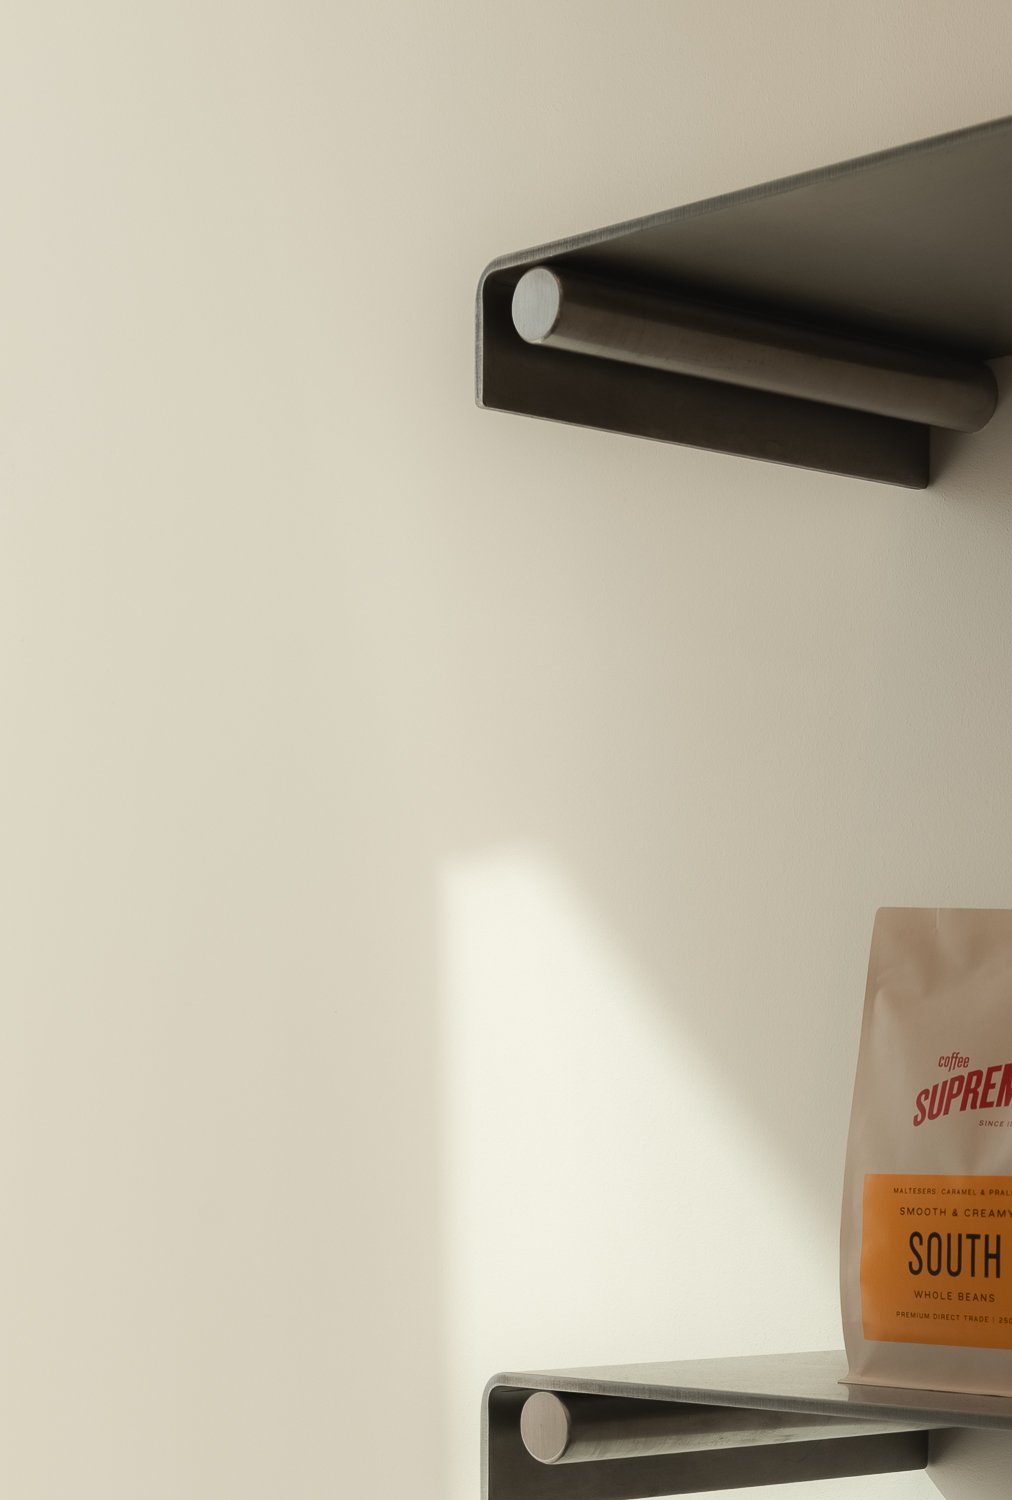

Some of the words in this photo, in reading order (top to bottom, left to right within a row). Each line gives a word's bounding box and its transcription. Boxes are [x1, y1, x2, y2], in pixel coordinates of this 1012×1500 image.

[938, 1052, 970, 1072] coffee
[978, 1120, 1004, 1128] SINCE
[941, 1188, 977, 1196] CARAMEL
[900, 1207, 947, 1216] SMOOTH
[952, 1209, 958, 1217] &
[908, 1231, 1001, 1278] SOUTH
[914, 1290, 953, 1301] WHOLE
[958, 1292, 995, 1302] BEANS
[896, 1311, 930, 1319] PREMIUM
[964, 1315, 988, 1323] TRADE
